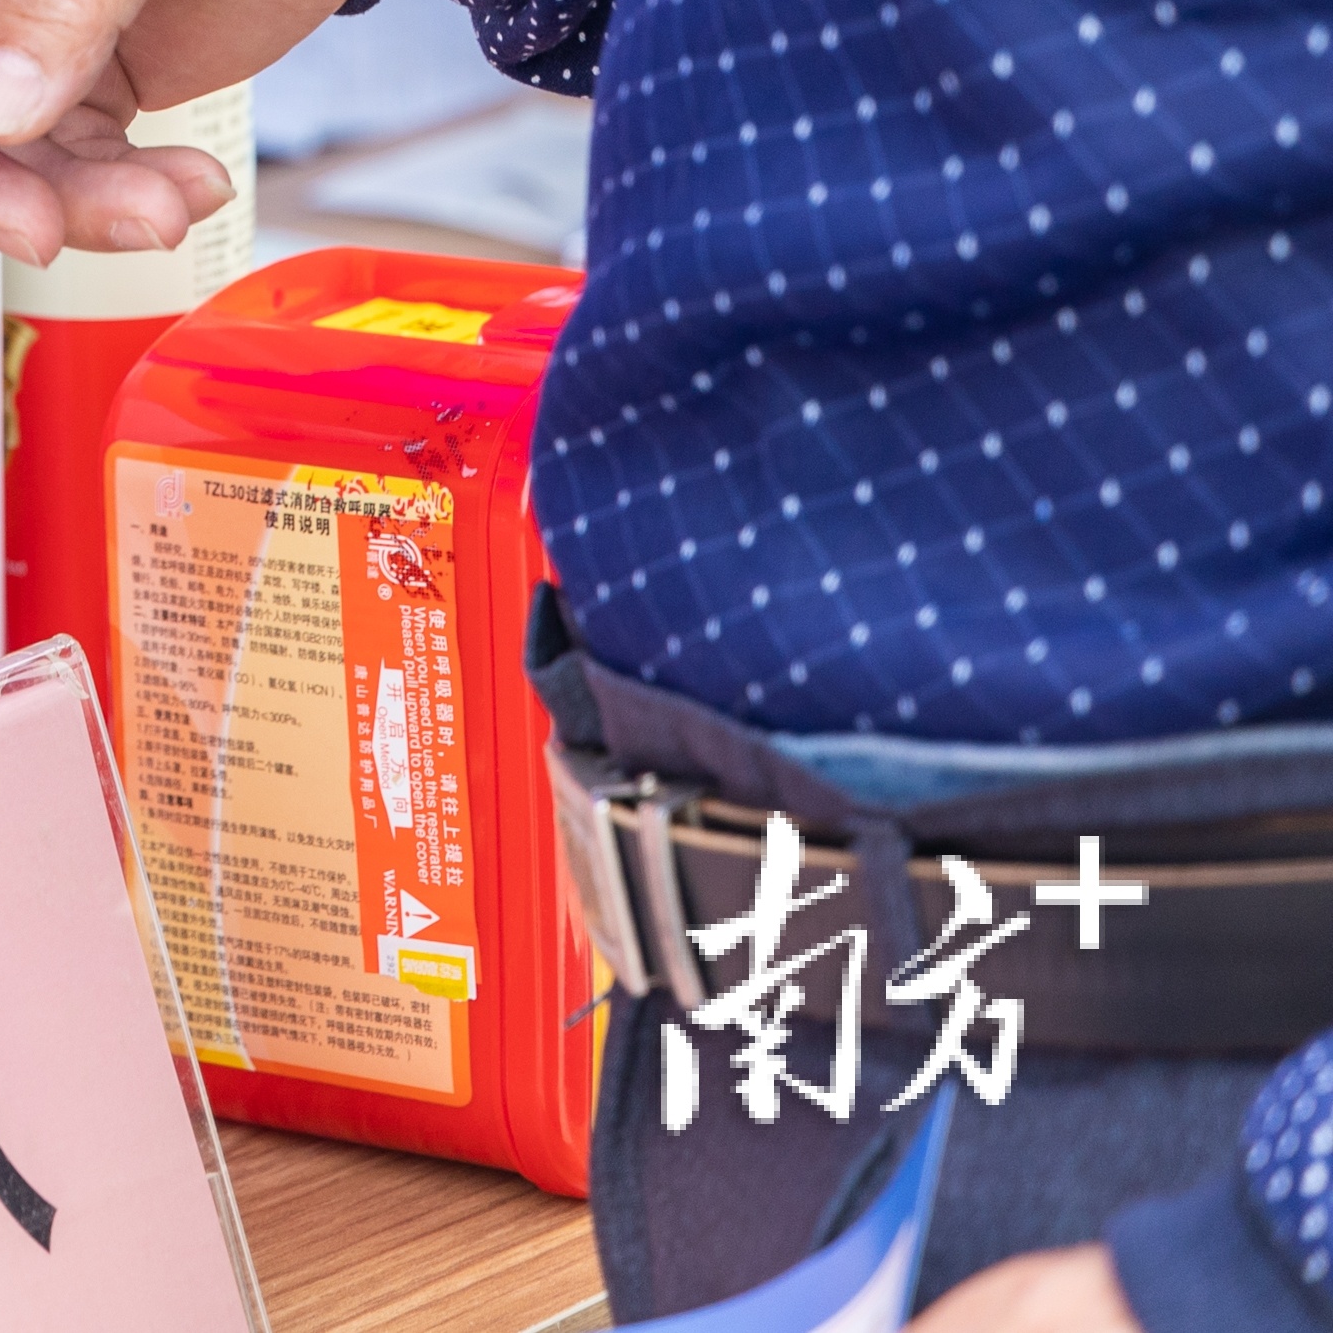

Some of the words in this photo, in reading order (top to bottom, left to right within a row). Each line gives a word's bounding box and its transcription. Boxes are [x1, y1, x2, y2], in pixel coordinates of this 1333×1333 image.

[203, 479, 391, 519] TZL30过滤式消防自救呼吸器
[264, 511, 331, 537] 使用说明
[399, 604, 415, 656] please
[413, 606, 428, 652] When
[403, 659, 419, 688] pull
[414, 655, 429, 684] you
[377, 706, 388, 740] Open
[405, 691, 422, 749] upward
[419, 687, 434, 727] need
[386, 683, 410, 814] 开启方向
[421, 731, 434, 745] to
[379, 743, 391, 790] Method
[410, 753, 423, 768] to
[423, 749, 435, 777] use
[410, 771, 424, 810] open
[425, 780, 439, 809] this
[415, 813, 428, 838] the
[416, 841, 429, 885] cover
[425, 811, 442, 886] respirator
[383, 869, 399, 937] WARNIN
